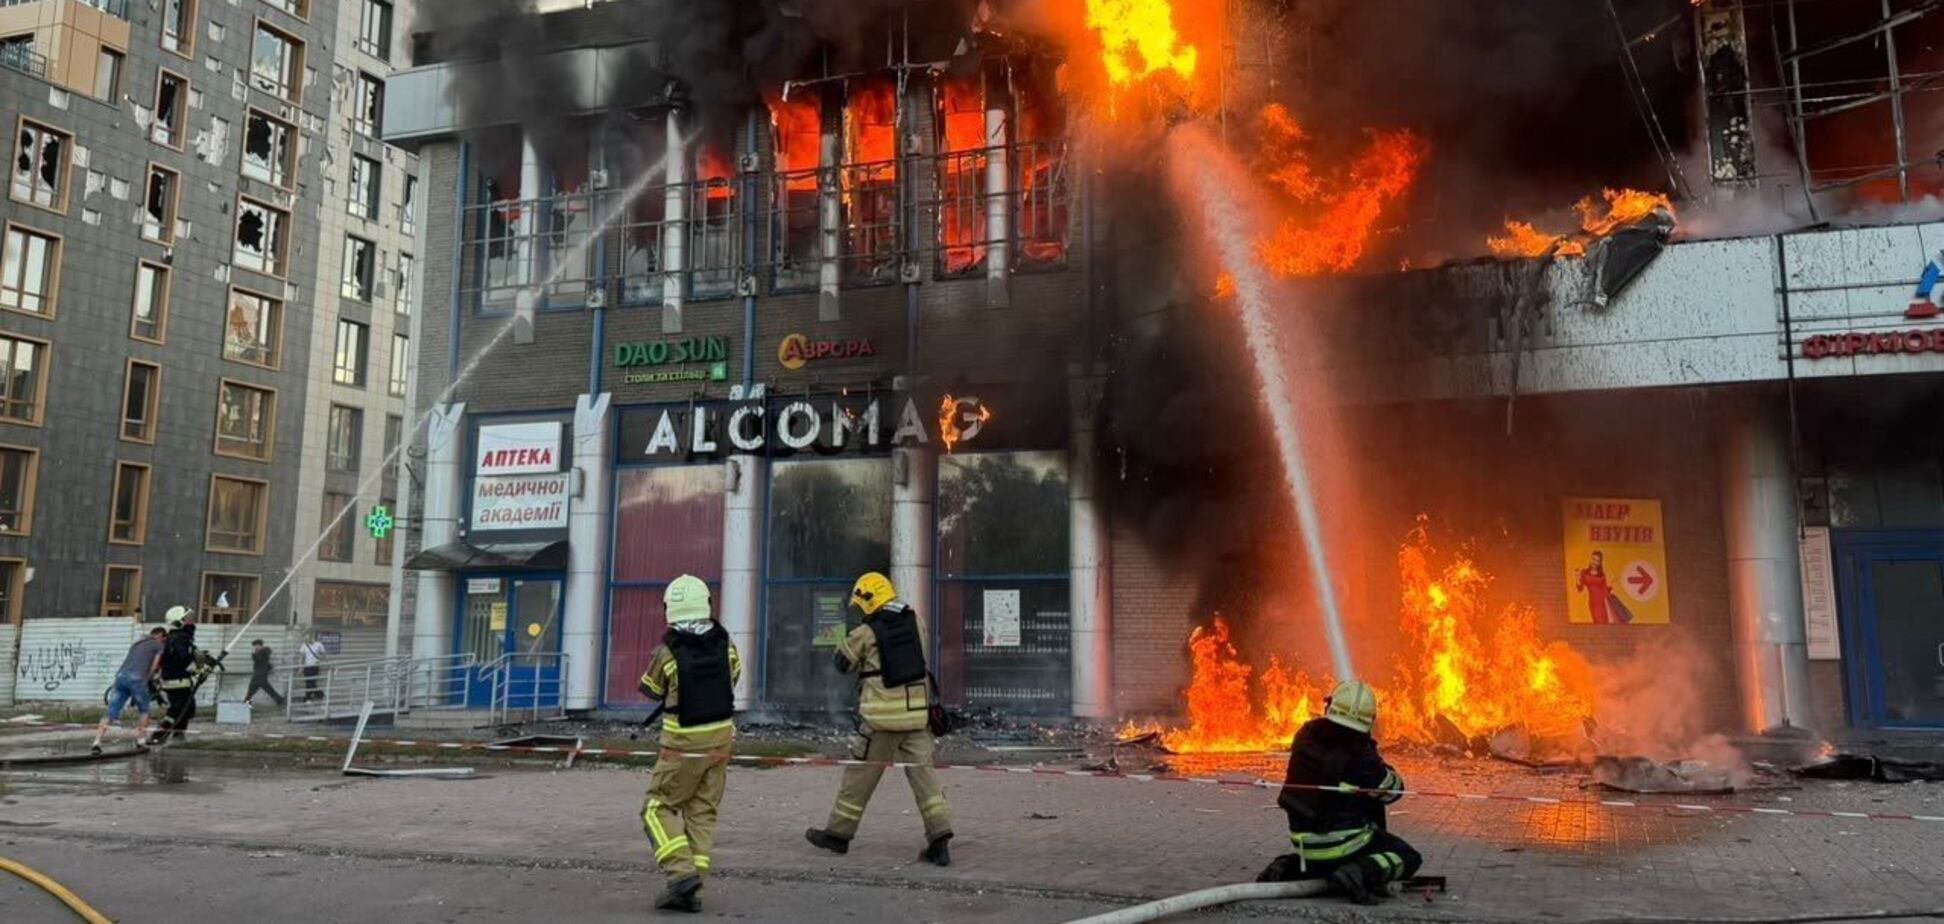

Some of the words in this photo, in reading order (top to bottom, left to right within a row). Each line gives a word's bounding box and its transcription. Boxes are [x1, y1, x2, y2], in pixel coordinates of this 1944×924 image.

[614, 340, 669, 366] DAO
[674, 336, 728, 361] SUN
[783, 337, 874, 361] АВРОРА
[644, 397, 983, 455] ALCOMAG
[481, 448, 552, 467] АПТЕКА
[480, 501, 562, 523] академії
